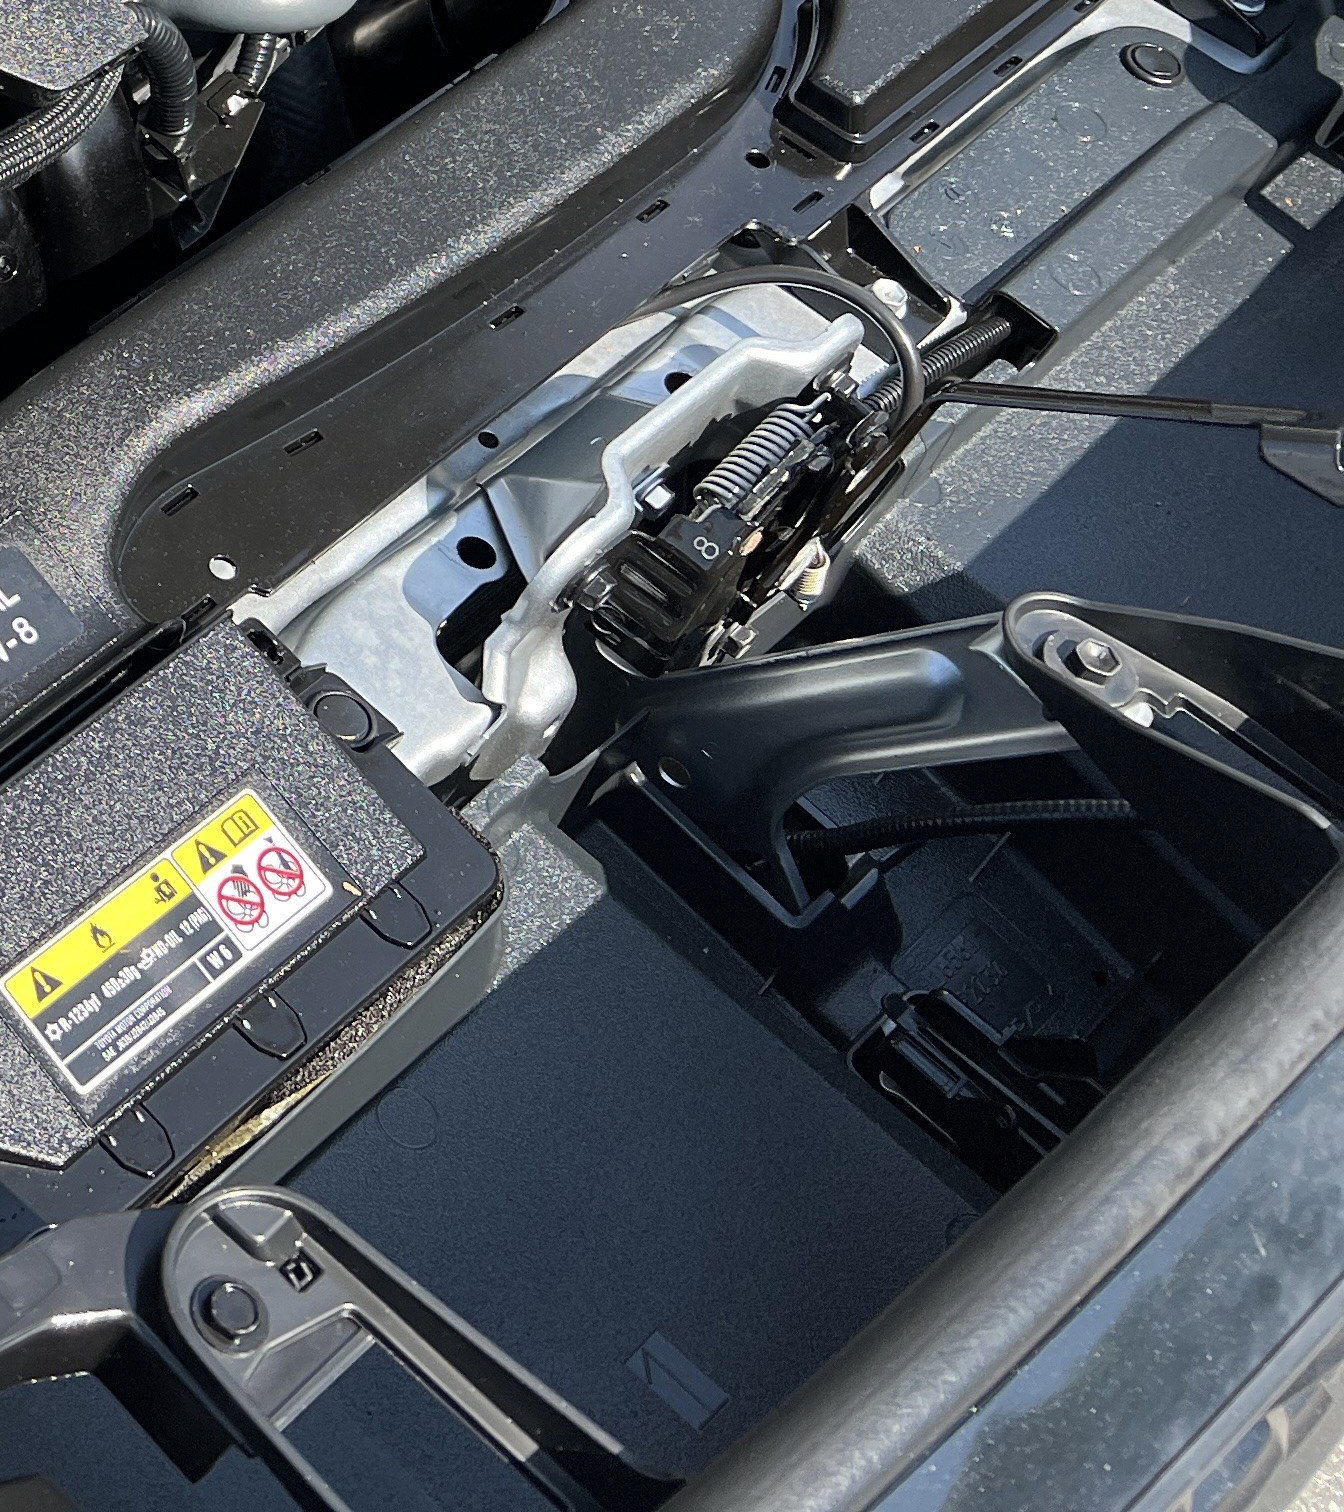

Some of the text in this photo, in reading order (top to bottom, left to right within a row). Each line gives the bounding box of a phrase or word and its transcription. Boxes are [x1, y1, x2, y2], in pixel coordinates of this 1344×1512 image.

[693, 536, 720, 562] 8
[206, 948, 227, 970] W
[58, 991, 103, 1032] R-1234yf
[178, 919, 194, 937] 12
[94, 984, 173, 1050] TOYOTA MOTOR CORPORATION
[101, 1046, 117, 1062] SAE
